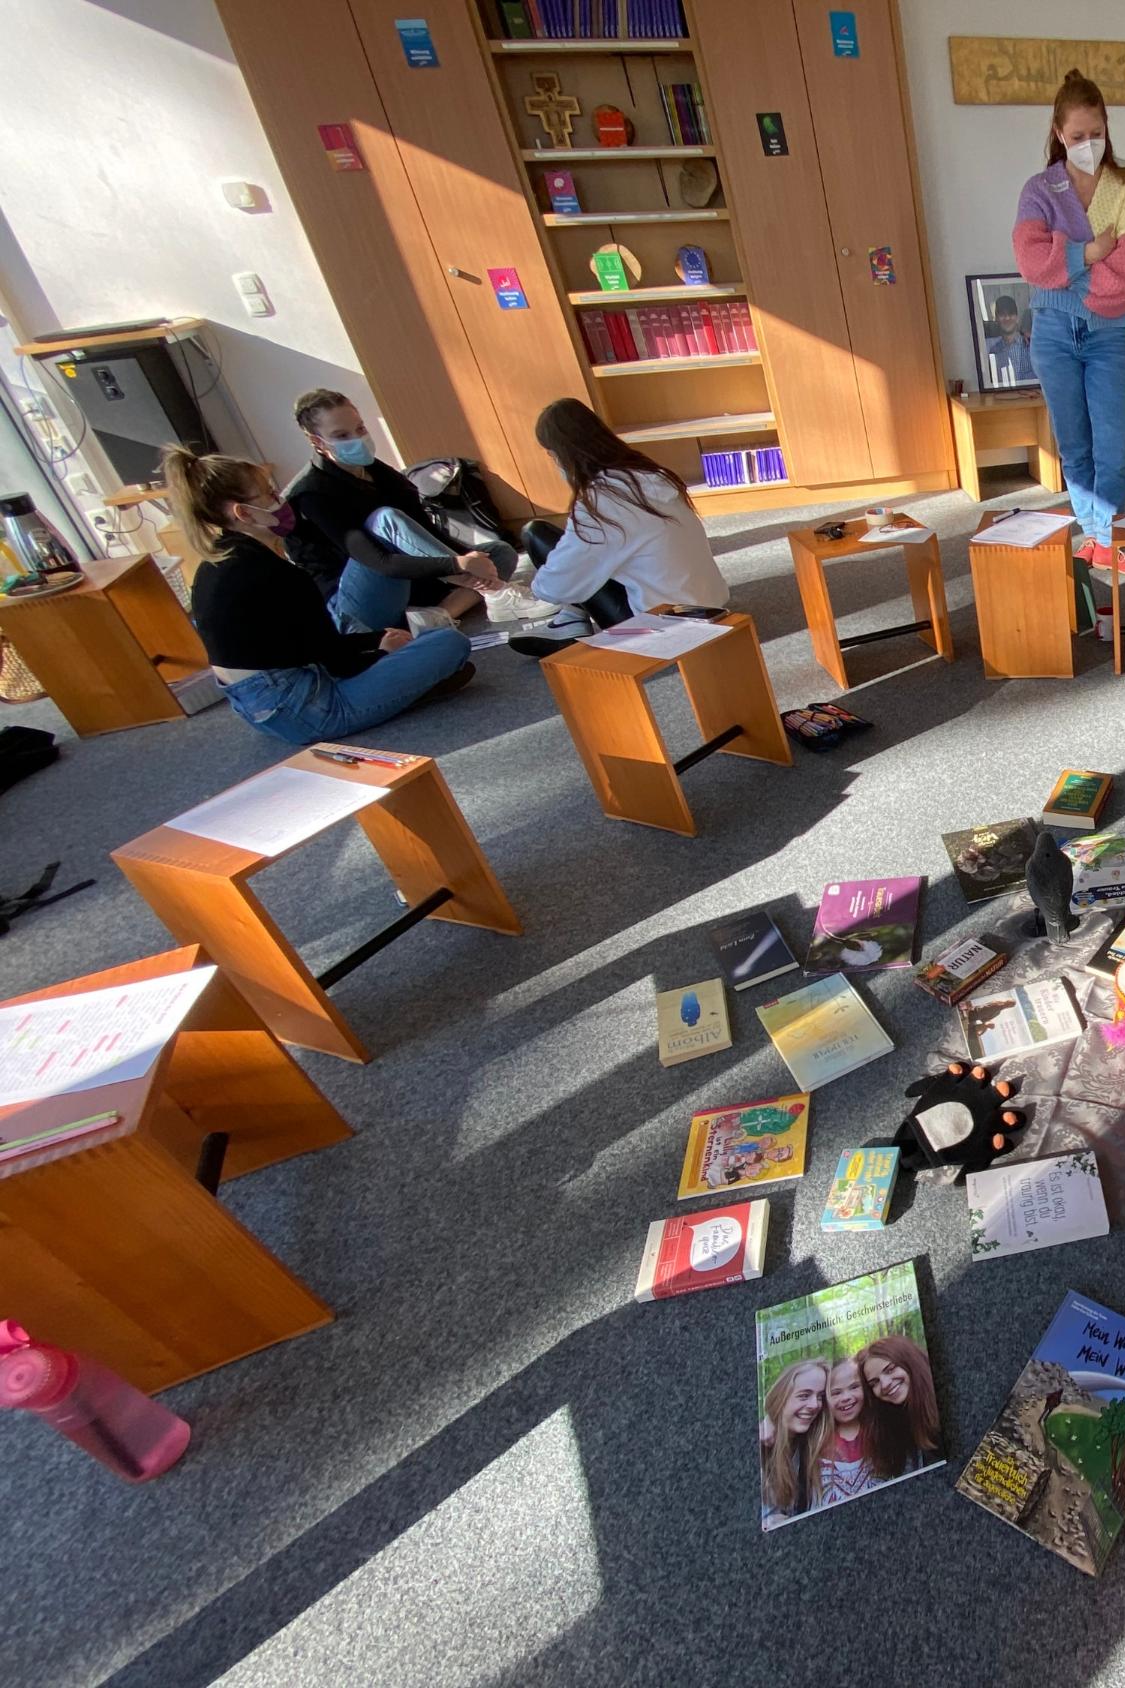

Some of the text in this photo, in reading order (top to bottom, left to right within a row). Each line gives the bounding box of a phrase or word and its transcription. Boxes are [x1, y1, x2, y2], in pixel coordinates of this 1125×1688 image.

[948, 943, 983, 971] NATUR
[667, 1028, 723, 1049] Albom
[700, 1124, 721, 1181] Sternenkind
[1019, 1177, 1038, 1227] traurig bist
[1036, 1180, 1053, 1219] wenn du
[1048, 1171, 1067, 1222] Es ist okay,
[846, 1293, 913, 1321] Geschwisterliebe
[1082, 1320, 1110, 1345] Mein
[985, 1450, 1028, 1486] Trauerbuch
